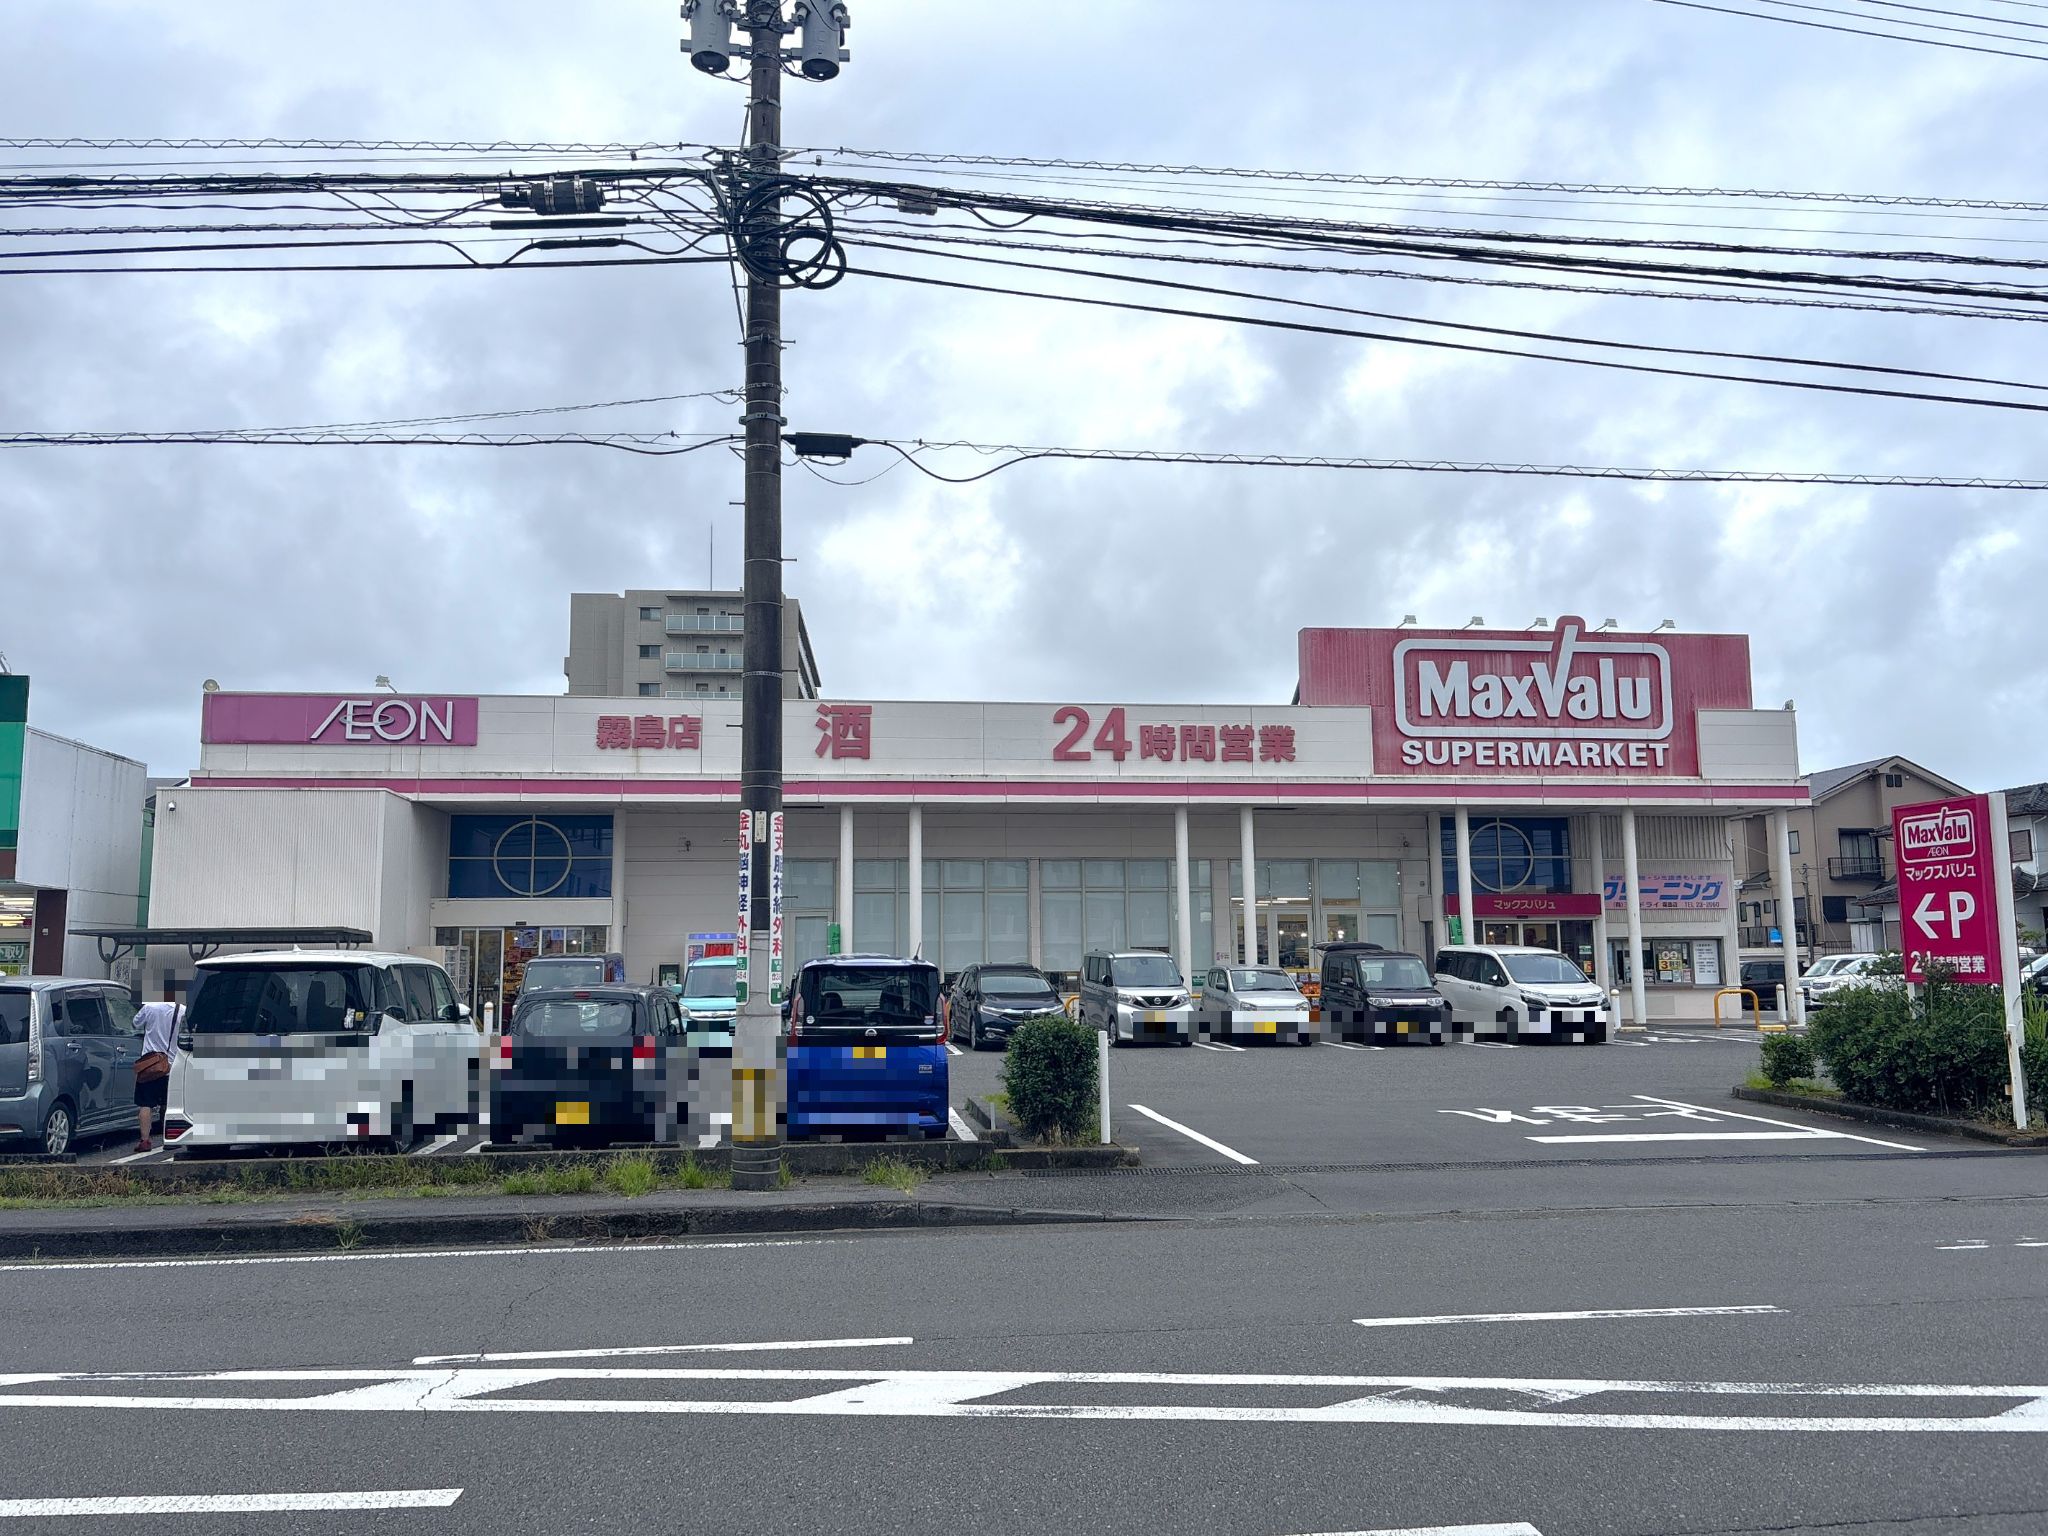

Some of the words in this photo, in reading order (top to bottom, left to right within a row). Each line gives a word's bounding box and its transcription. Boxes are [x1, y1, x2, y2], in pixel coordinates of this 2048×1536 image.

[1418, 625, 1652, 720] MaxValu
[596, 714, 701, 750] 霧島店
[815, 703, 873, 760] 酒
[1053, 706, 1296, 762] 24時間営業
[1401, 740, 1670, 767] SUPERMARKET
[1907, 808, 1967, 845] MaxValu
[1905, 863, 1976, 881] マックスバリュ
[1949, 891, 1975, 939] P
